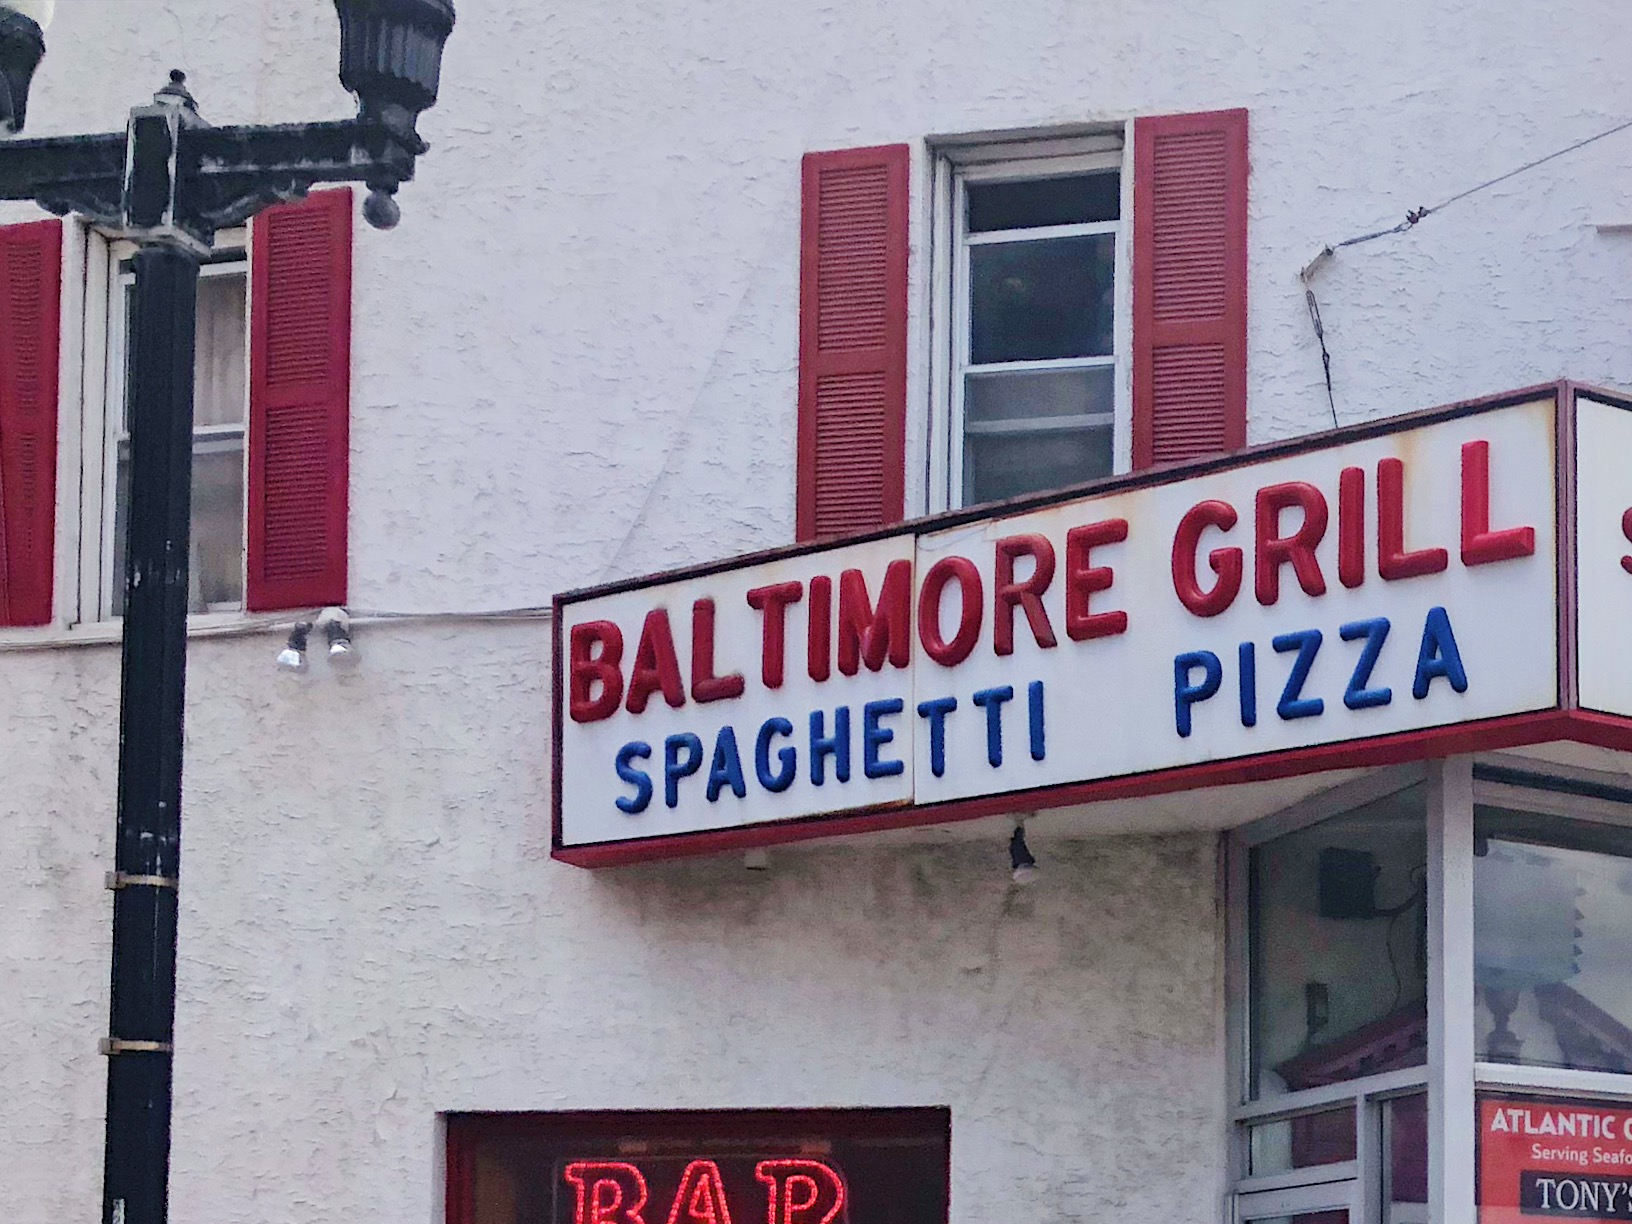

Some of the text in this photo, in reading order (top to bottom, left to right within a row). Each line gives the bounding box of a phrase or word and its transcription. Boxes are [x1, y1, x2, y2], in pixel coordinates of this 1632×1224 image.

[569, 440, 1535, 723] BALTIMORE GRILL
[614, 606, 1467, 816] SPAGHETTI PIZZA
[1491, 1107, 1616, 1140] ATLANTIC
[1531, 1143, 1589, 1166] Serving
